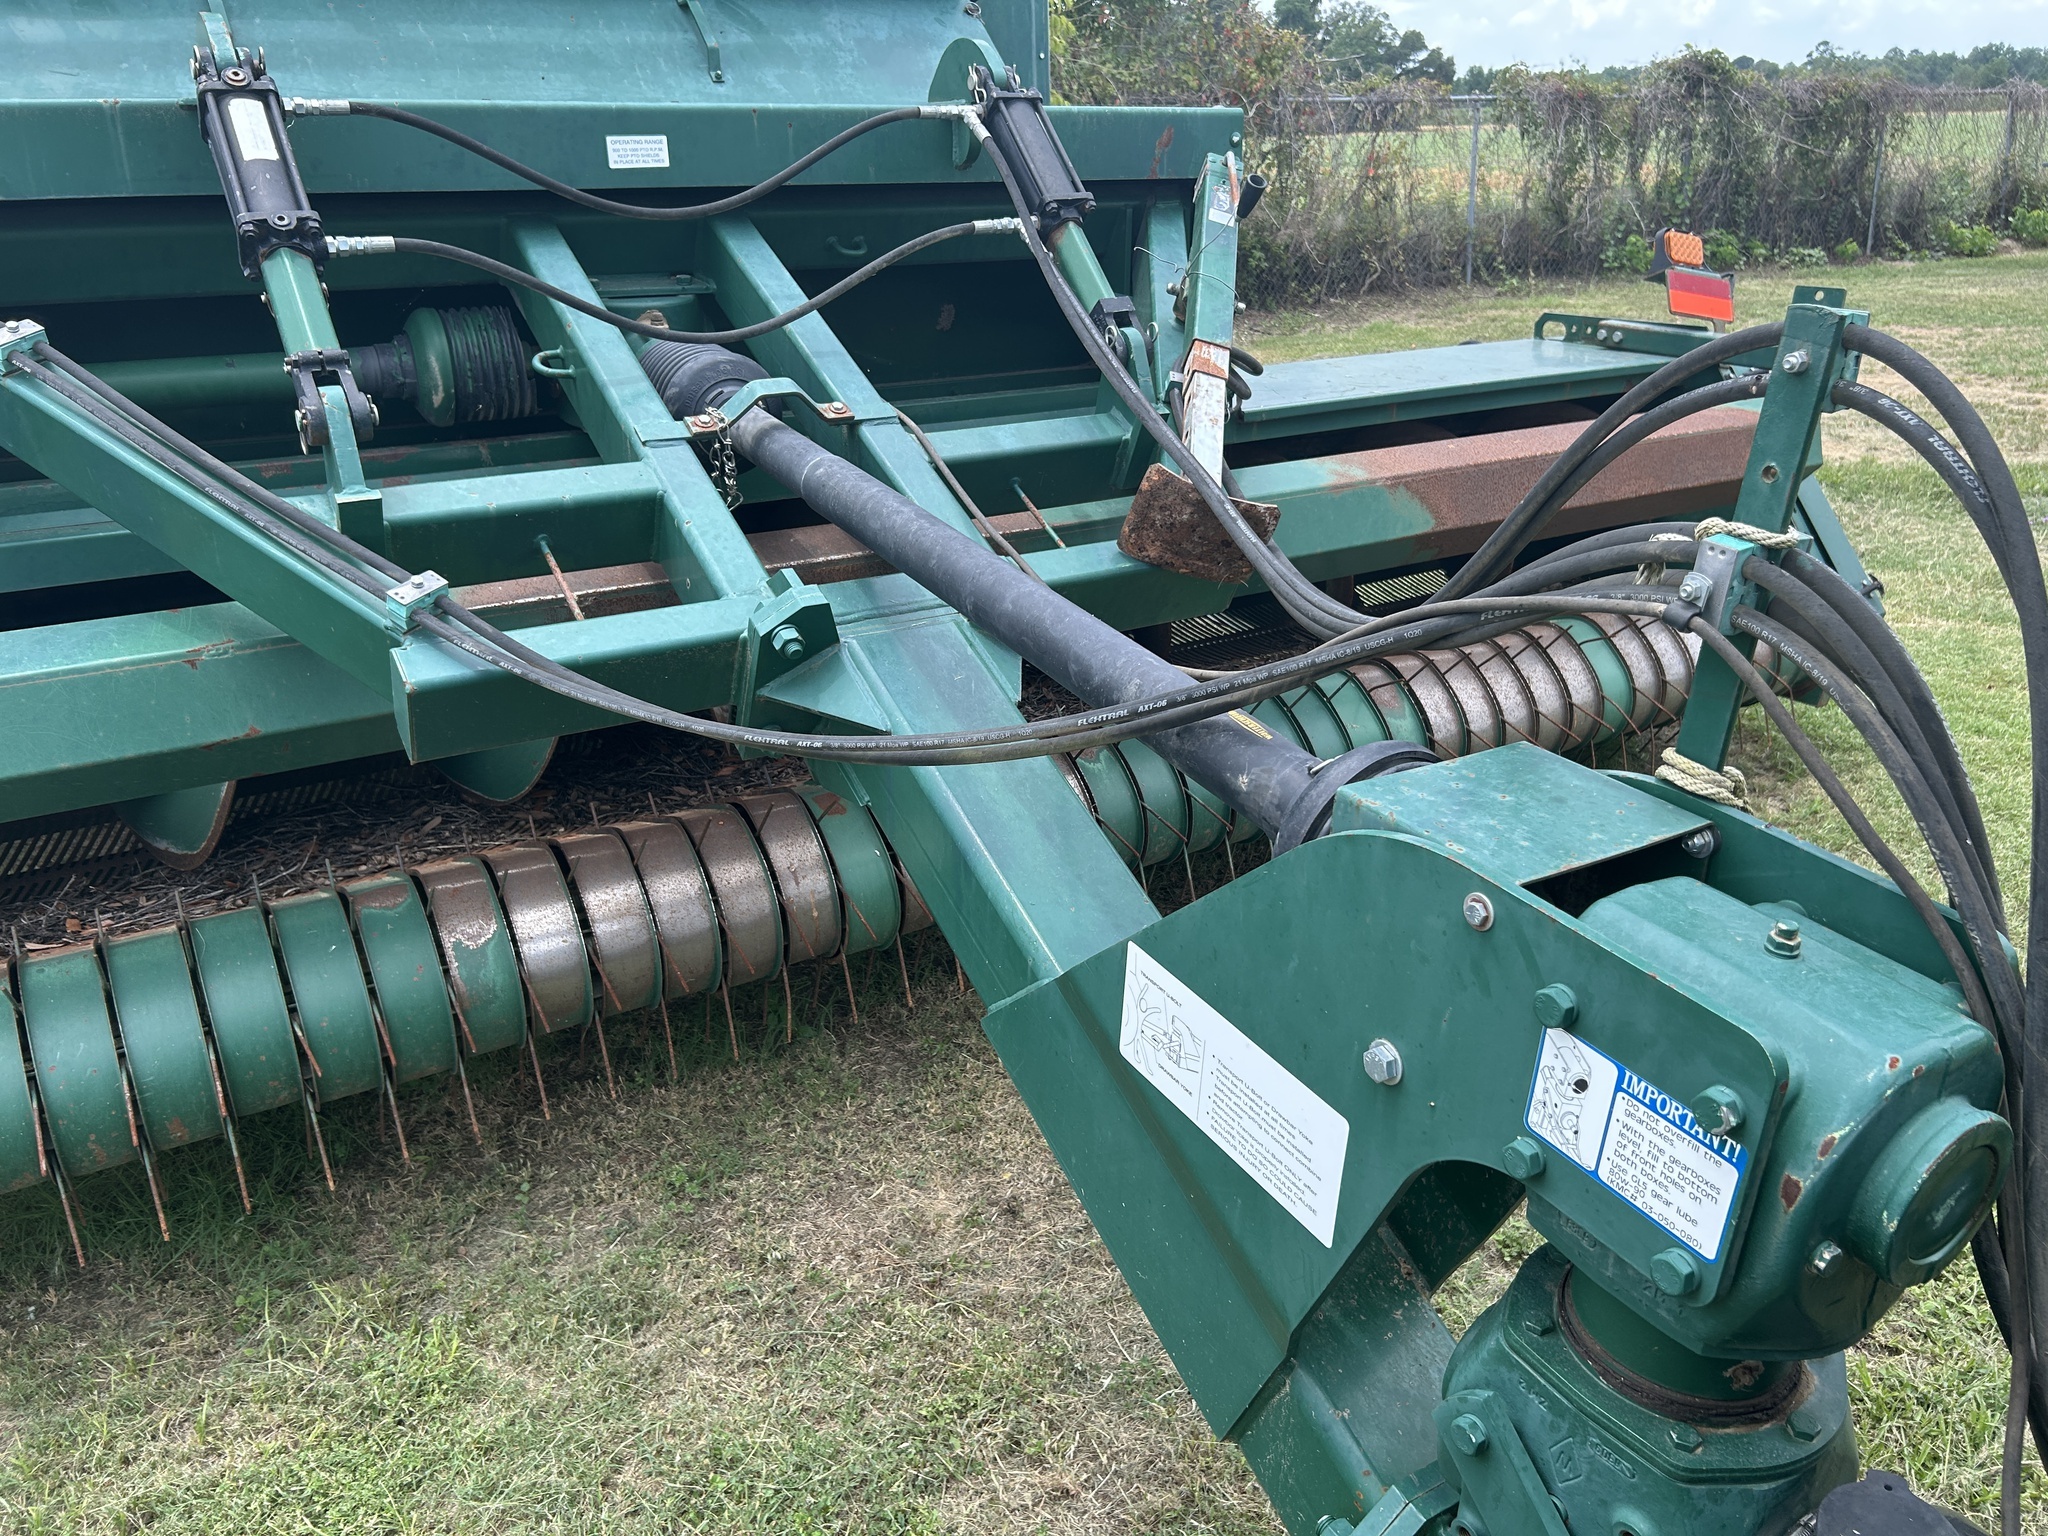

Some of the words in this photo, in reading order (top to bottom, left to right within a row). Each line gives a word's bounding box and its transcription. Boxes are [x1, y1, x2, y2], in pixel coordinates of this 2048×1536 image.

[1650, 594, 1665, 603] PSI
[498, 660, 523, 676] AXT-06
[1137, 698, 1169, 714] AXT-06
[1207, 684, 1220, 696] PSI
[1233, 679, 1242, 688] 21
[1256, 671, 1270, 683] WP
[1272, 663, 1299, 678] SAE100
[1299, 660, 1313, 671] R17
[1315, 653, 1337, 666] MSHA
[1364, 636, 1395, 651] USCG-H
[1403, 627, 1424, 640] 1Q20
[1731, 614, 1761, 636] SAE100
[1761, 630, 1778, 645] R17
[1779, 642, 1803, 664] MSHA
[1802, 661, 1829, 687] IC-8/19
[796, 740, 824, 749] AXT-06
[900, 741, 910, 749] WP
[1140, 969, 1167, 995] TRANSPORT
[1180, 1082, 1194, 1098] YOKE
[1213, 1092, 1225, 1104] and
[1215, 1067, 1230, 1082] must
[1230, 1080, 1239, 1090] be
[1239, 1087, 1263, 1112] installed
[1263, 1109, 1270, 1118] at
[1270, 1115, 1279, 1125] all
[1215, 1074, 1242, 1102] Transport
[1242, 1099, 1261, 1119] U-Bolt
[1261, 1116, 1277, 1133] must
[1277, 1130, 1286, 1141] be
[1217, 1057, 1244, 1085] Transport
[1244, 1082, 1263, 1102] U-Bolt
[1271, 1105, 1297, 1131] Drawbar
[1297, 1128, 1314, 1146] Yoke
[1620, 1068, 1742, 1163] IMPORTANT!
[1211, 1107, 1235, 1131] Drawbar
[1235, 1128, 1249, 1145] Yoke
[1255, 1148, 1280, 1172] properly
[1212, 1099, 1236, 1123] Remove
[1236, 1120, 1264, 1149] Transport
[1264, 1146, 1284, 1167] U-Bolt
[1284, 1164, 1302, 1182] ONLY
[1302, 1182, 1318, 1197] after
[1214, 1083, 1232, 1102] before
[1233, 1101, 1263, 1130] attempting
[1263, 1127, 1271, 1136] to
[1270, 1134, 1295, 1158] connect
[1295, 1155, 1322, 1182] combine
[1621, 1120, 1646, 1143] With
[1648, 1139, 1666, 1157] the
[1668, 1154, 1722, 1196] gearboxes
[1624, 1108, 1677, 1149] gearboxes.
[1626, 1098, 1640, 1113] Do
[1642, 1110, 1661, 1127] not
[1663, 1125, 1700, 1154] overfill
[1703, 1150, 1723, 1168] the
[1210, 1123, 1238, 1152] SERIOUS
[1238, 1149, 1262, 1173] INJURY
[1262, 1172, 1273, 1186] OR
[1273, 1182, 1299, 1208] DEATH.
[1211, 1115, 1237, 1142] FAILURE
[1238, 1140, 1247, 1151] TO
[1247, 1148, 1258, 1161] DO
[1258, 1159, 1269, 1171] SO
[1269, 1169, 1293, 1194] COULD
[1293, 1191, 1318, 1217] CAUSE
[1611, 1158, 1628, 1177] Use
[1630, 1173, 1648, 1191] GL5
[1650, 1188, 1674, 1208] gear
[1675, 1205, 1699, 1228] lube
[1613, 1148, 1638, 1171] both
[1640, 1166, 1671, 1195] boxes.
[1616, 1140, 1628, 1151] of
[1631, 1149, 1657, 1173] front
[1659, 1169, 1686, 1194] holes
[1688, 1191, 1703, 1206] on
[1618, 1129, 1643, 1153] level,
[1646, 1149, 1660, 1164] fill
[1662, 1160, 1675, 1174] to
[1677, 1170, 1719, 1205] bottom
[1606, 1175, 1639, 1203] (KMC#
[1641, 1200, 1703, 1250] 03-050-080)
